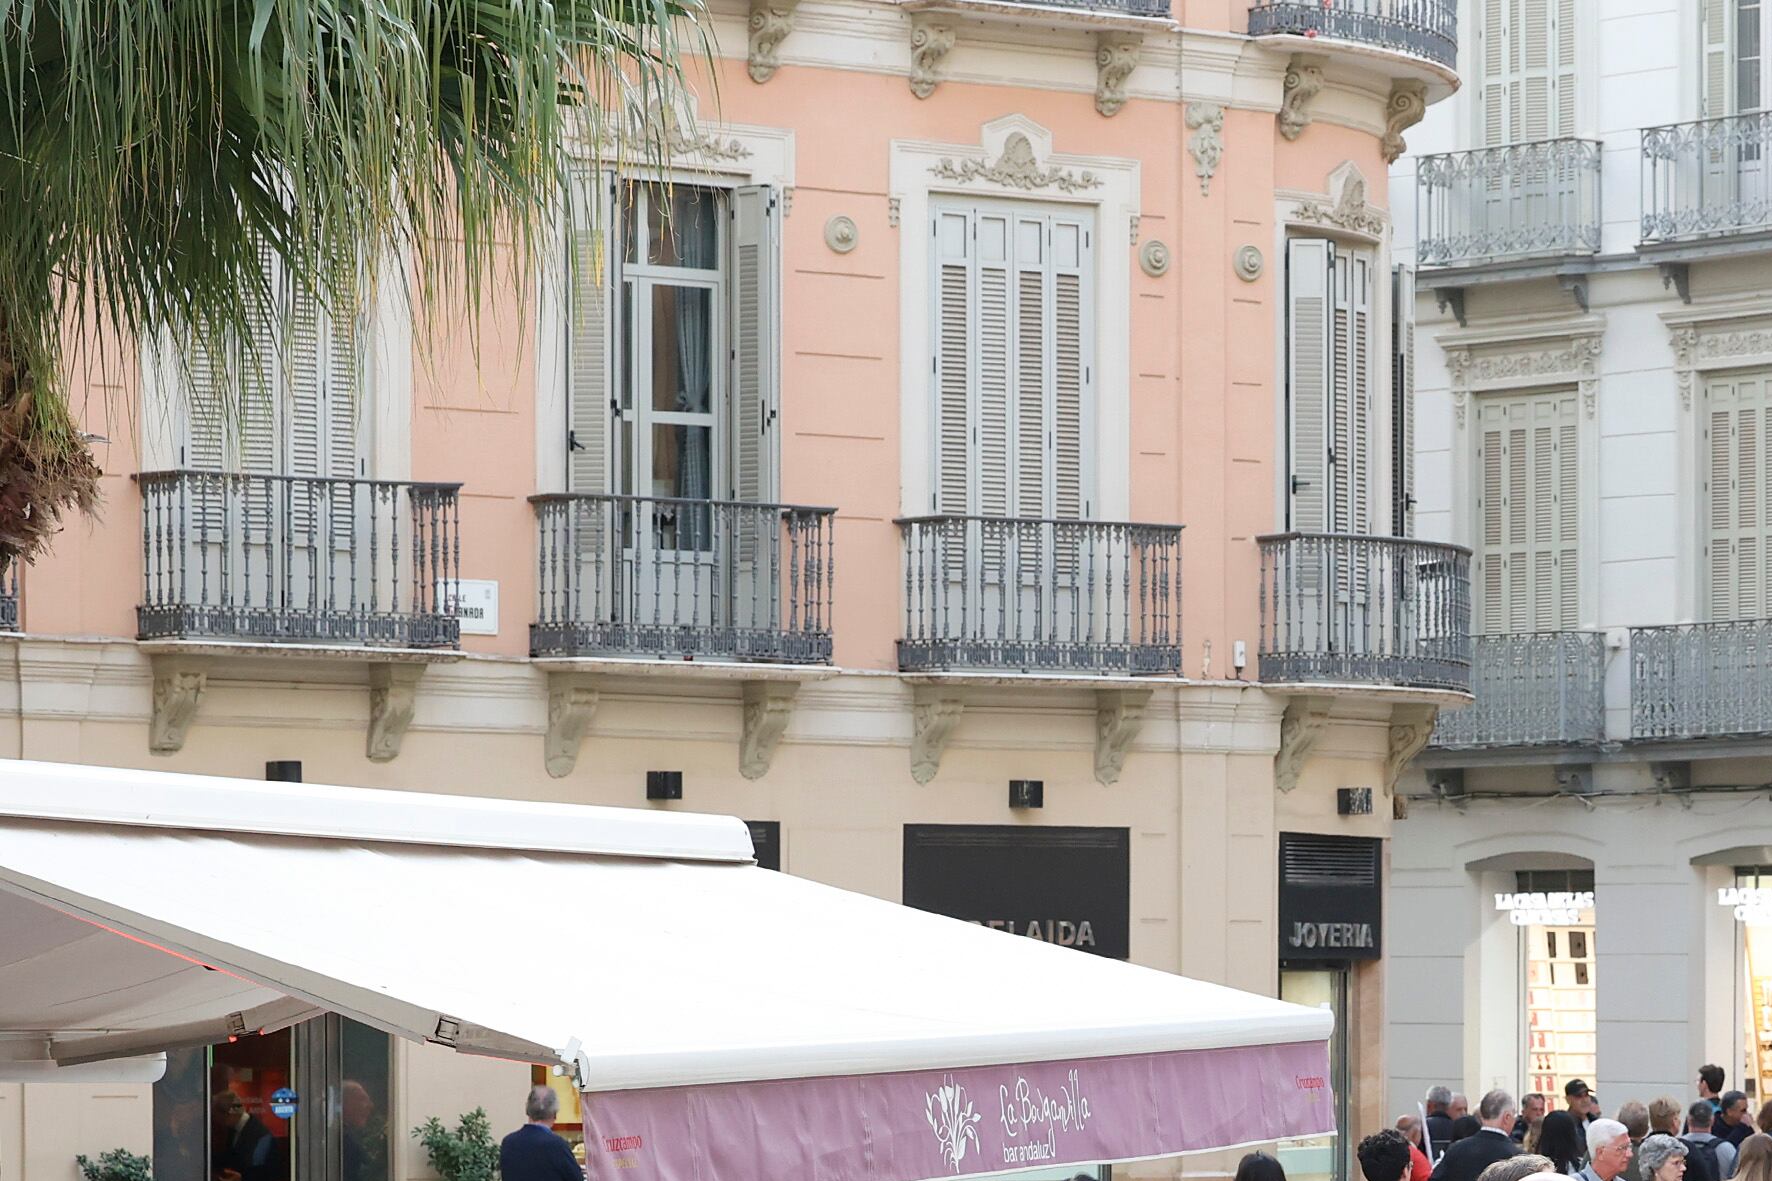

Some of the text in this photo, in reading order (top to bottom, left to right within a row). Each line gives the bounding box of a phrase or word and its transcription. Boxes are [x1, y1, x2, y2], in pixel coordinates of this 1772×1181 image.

[1288, 921, 1374, 948] JOYERIA
[1002, 1140, 1051, 1163] bar andaluz
